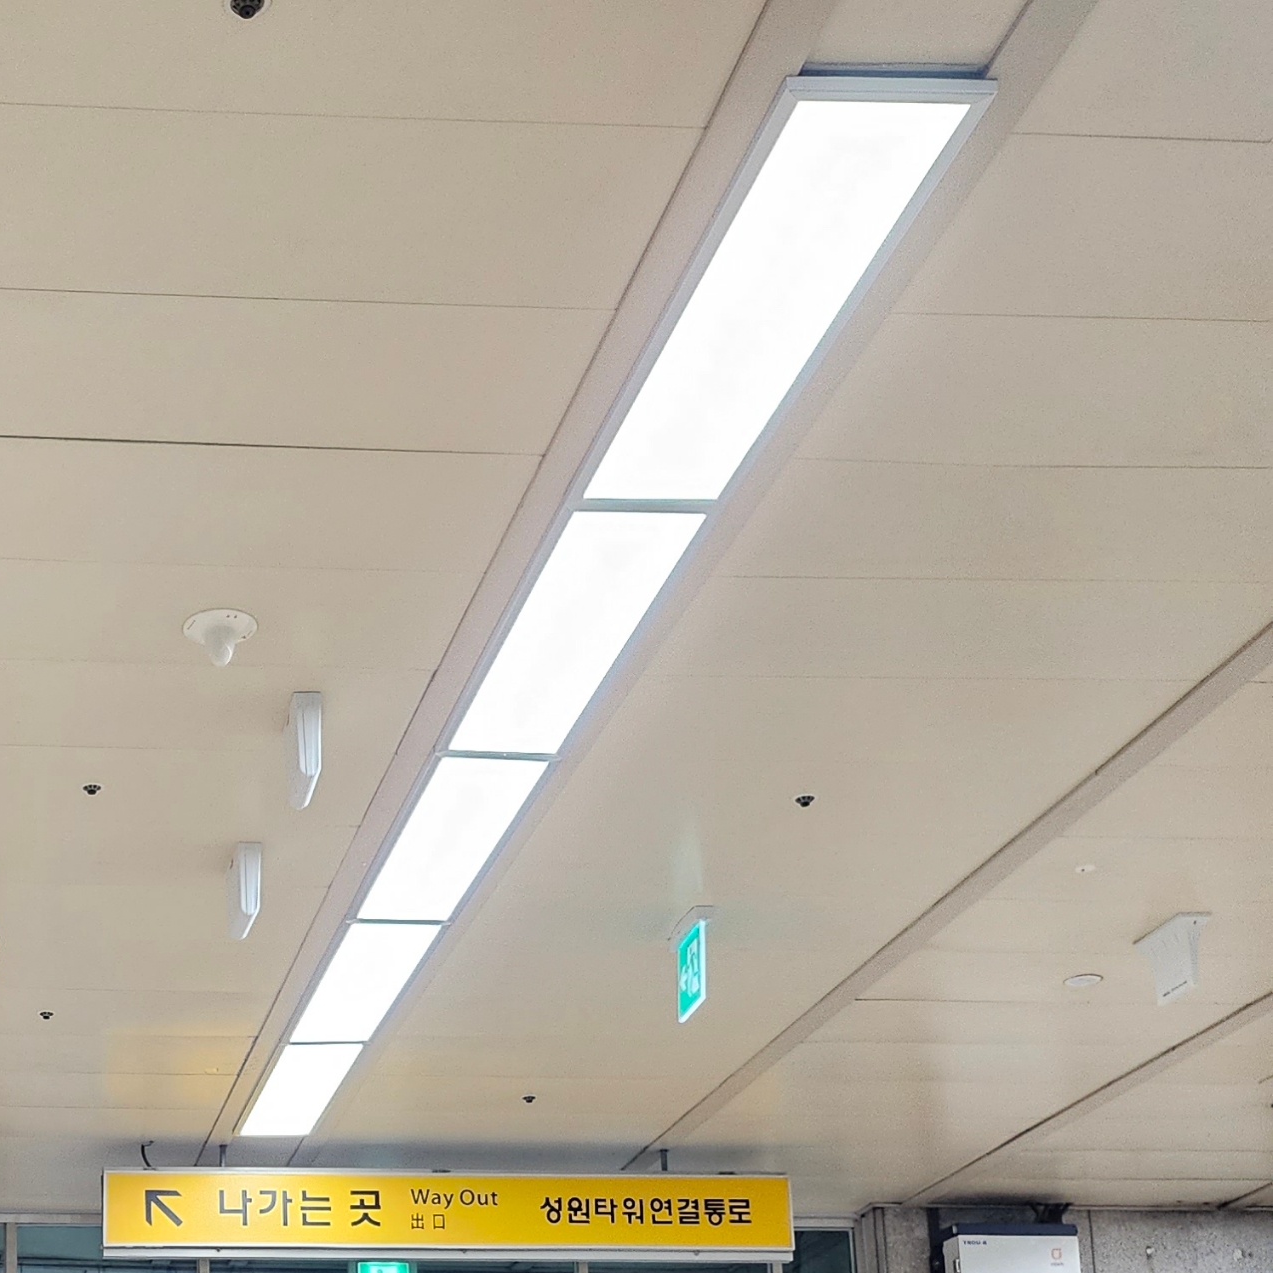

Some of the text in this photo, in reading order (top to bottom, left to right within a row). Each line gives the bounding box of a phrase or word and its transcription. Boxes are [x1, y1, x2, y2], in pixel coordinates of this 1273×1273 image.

[219, 1190, 382, 1227] 나가는 곳
[411, 1188, 499, 1209] Way Out
[539, 1196, 753, 1227] 성원타워연결통로
[411, 1213, 446, 1230] 出口
